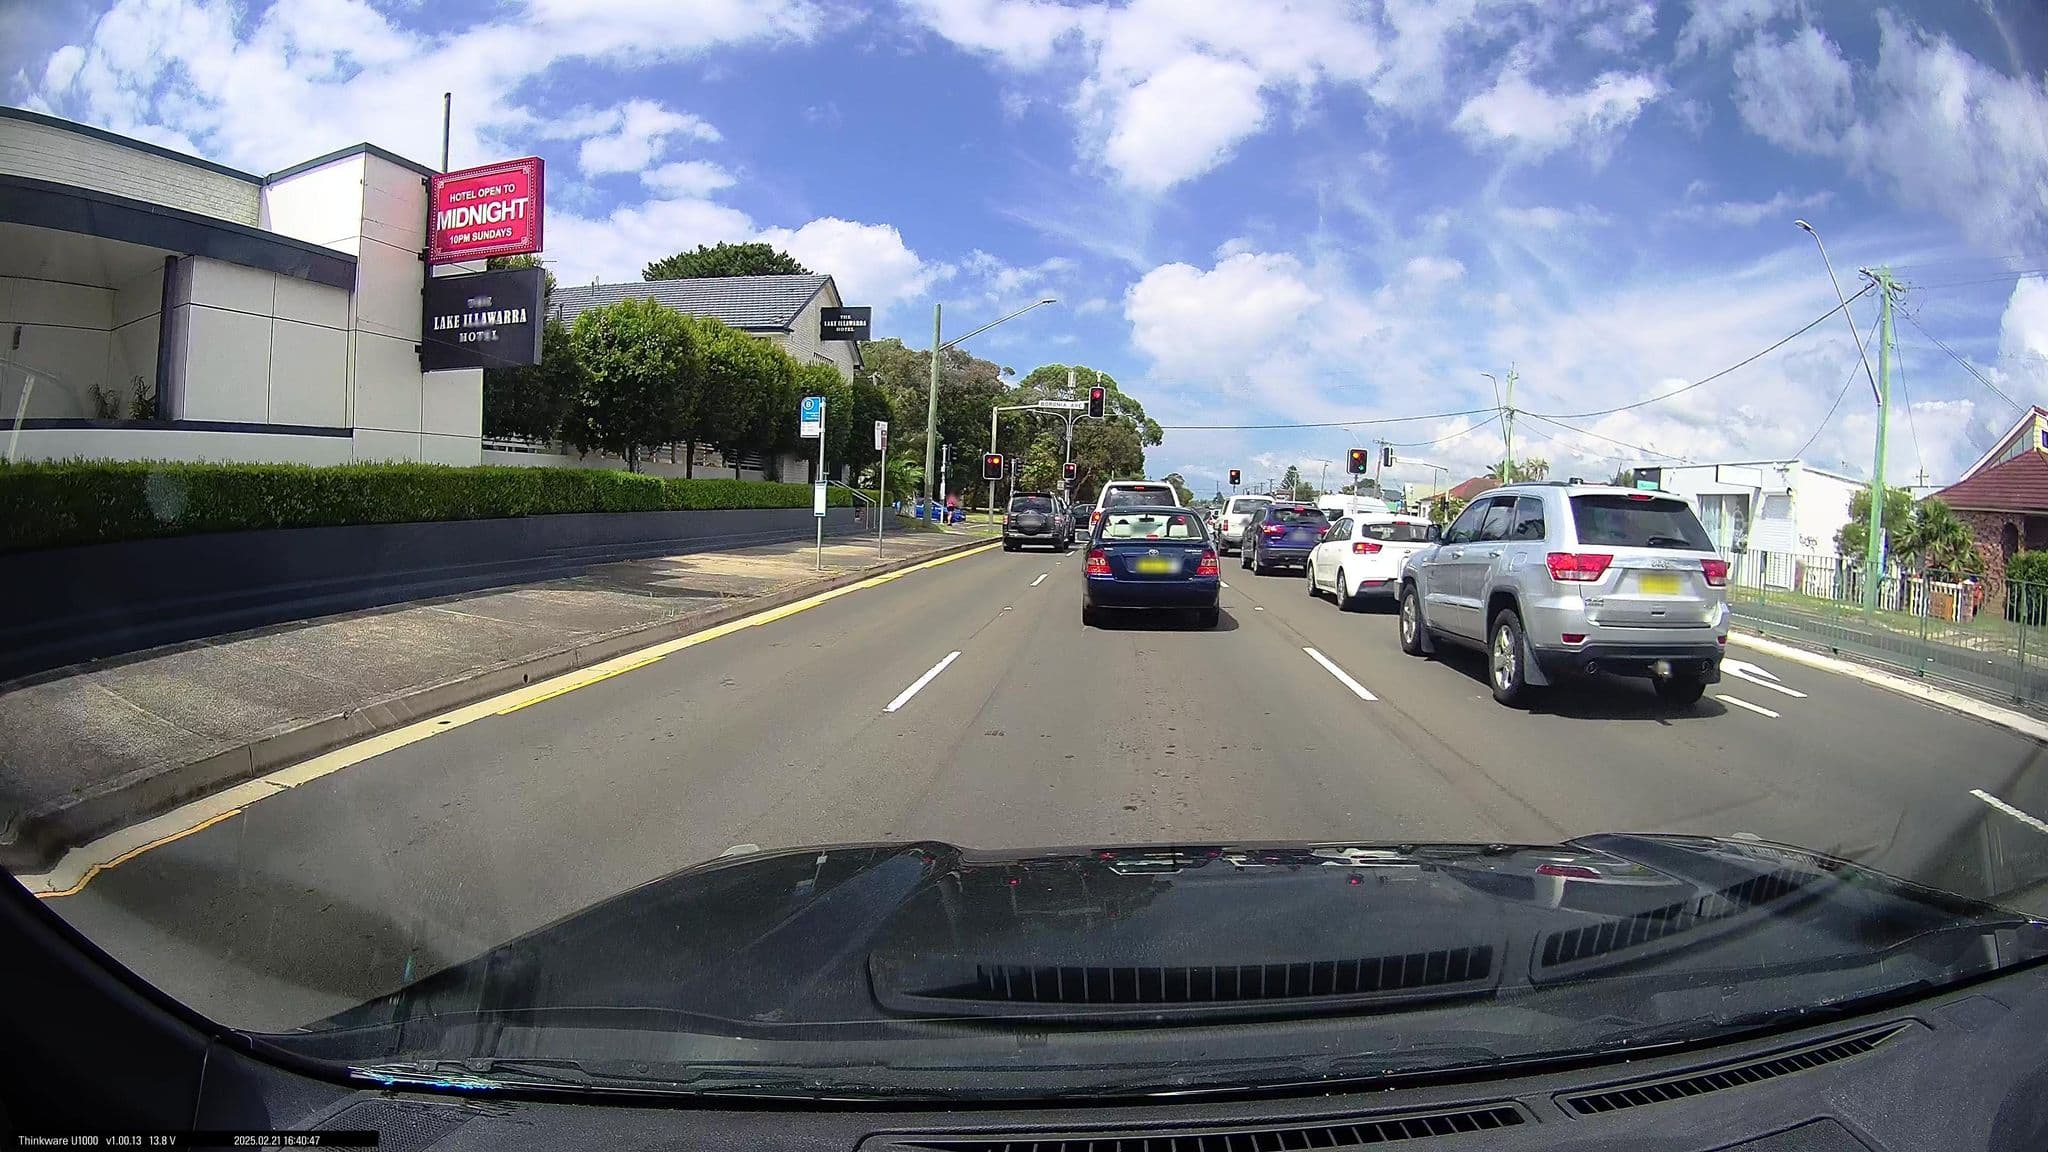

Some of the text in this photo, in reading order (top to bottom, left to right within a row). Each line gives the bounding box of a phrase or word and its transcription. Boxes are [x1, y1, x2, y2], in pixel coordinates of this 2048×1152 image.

[450, 183, 516, 203] HOTEL OPEN TO
[437, 197, 529, 231] MIDNIGHT
[450, 227, 512, 245] 10PM SUNDAYS
[434, 308, 527, 330] LAKE ILLAWARRA
